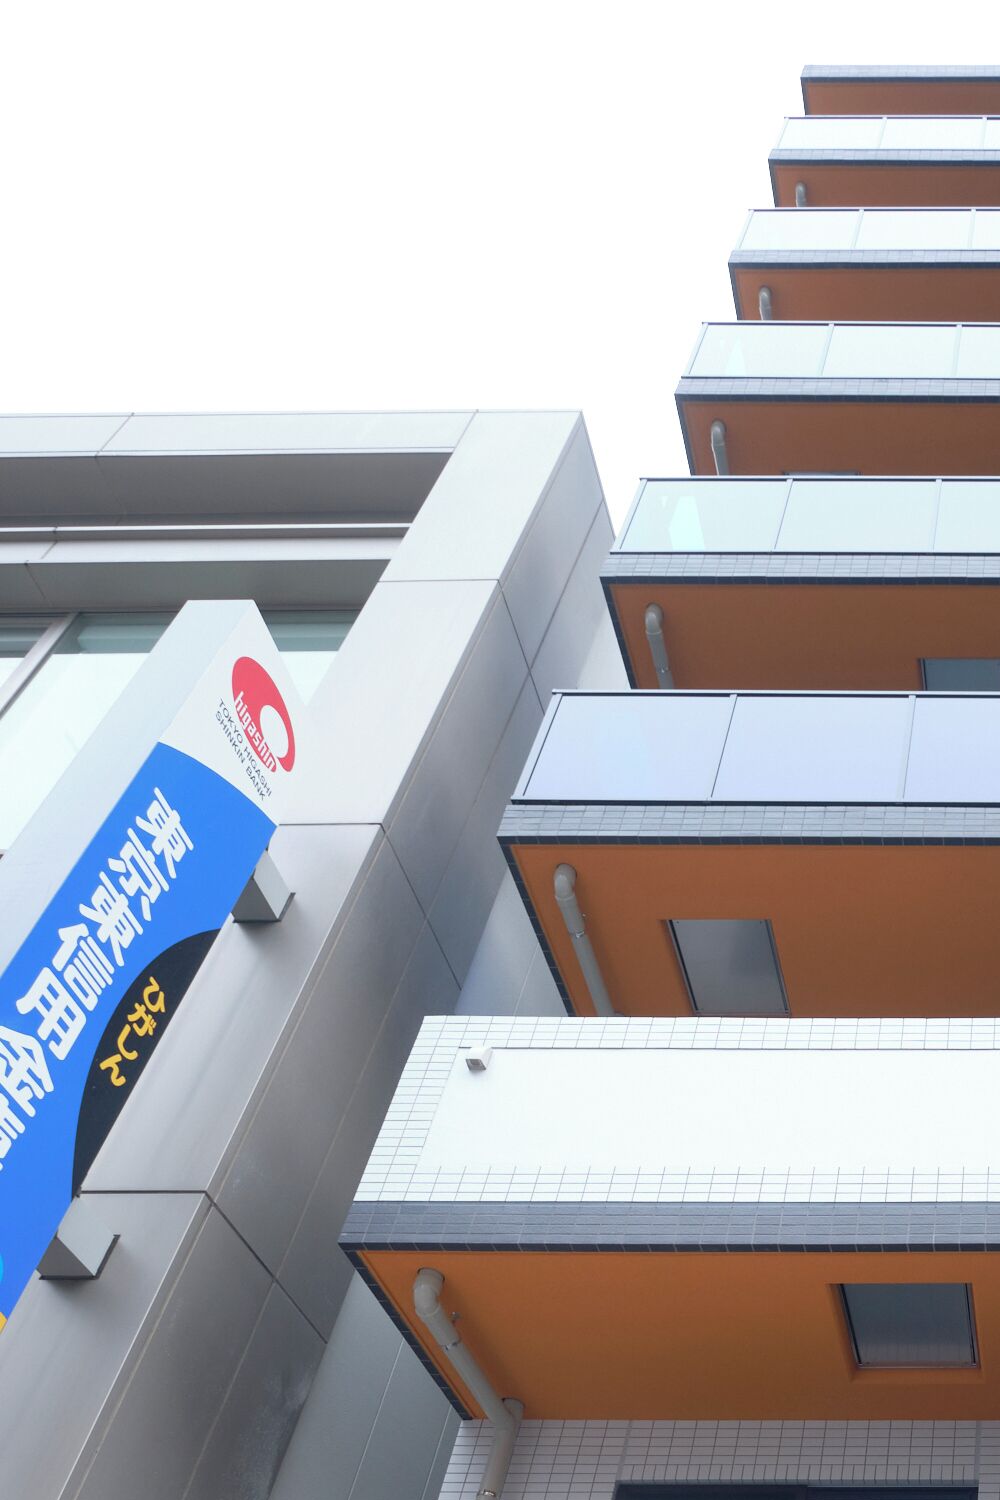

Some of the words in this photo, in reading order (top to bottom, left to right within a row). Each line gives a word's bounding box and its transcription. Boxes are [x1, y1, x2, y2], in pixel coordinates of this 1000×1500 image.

[215, 710, 246, 764] SHINKIN
[246, 766, 266, 801] BANK
[218, 698, 243, 744] TOKYO
[243, 746, 273, 797] HIGASHI
[234, 690, 276, 771] higashin
[99, 976, 166, 1087] ひがしん
